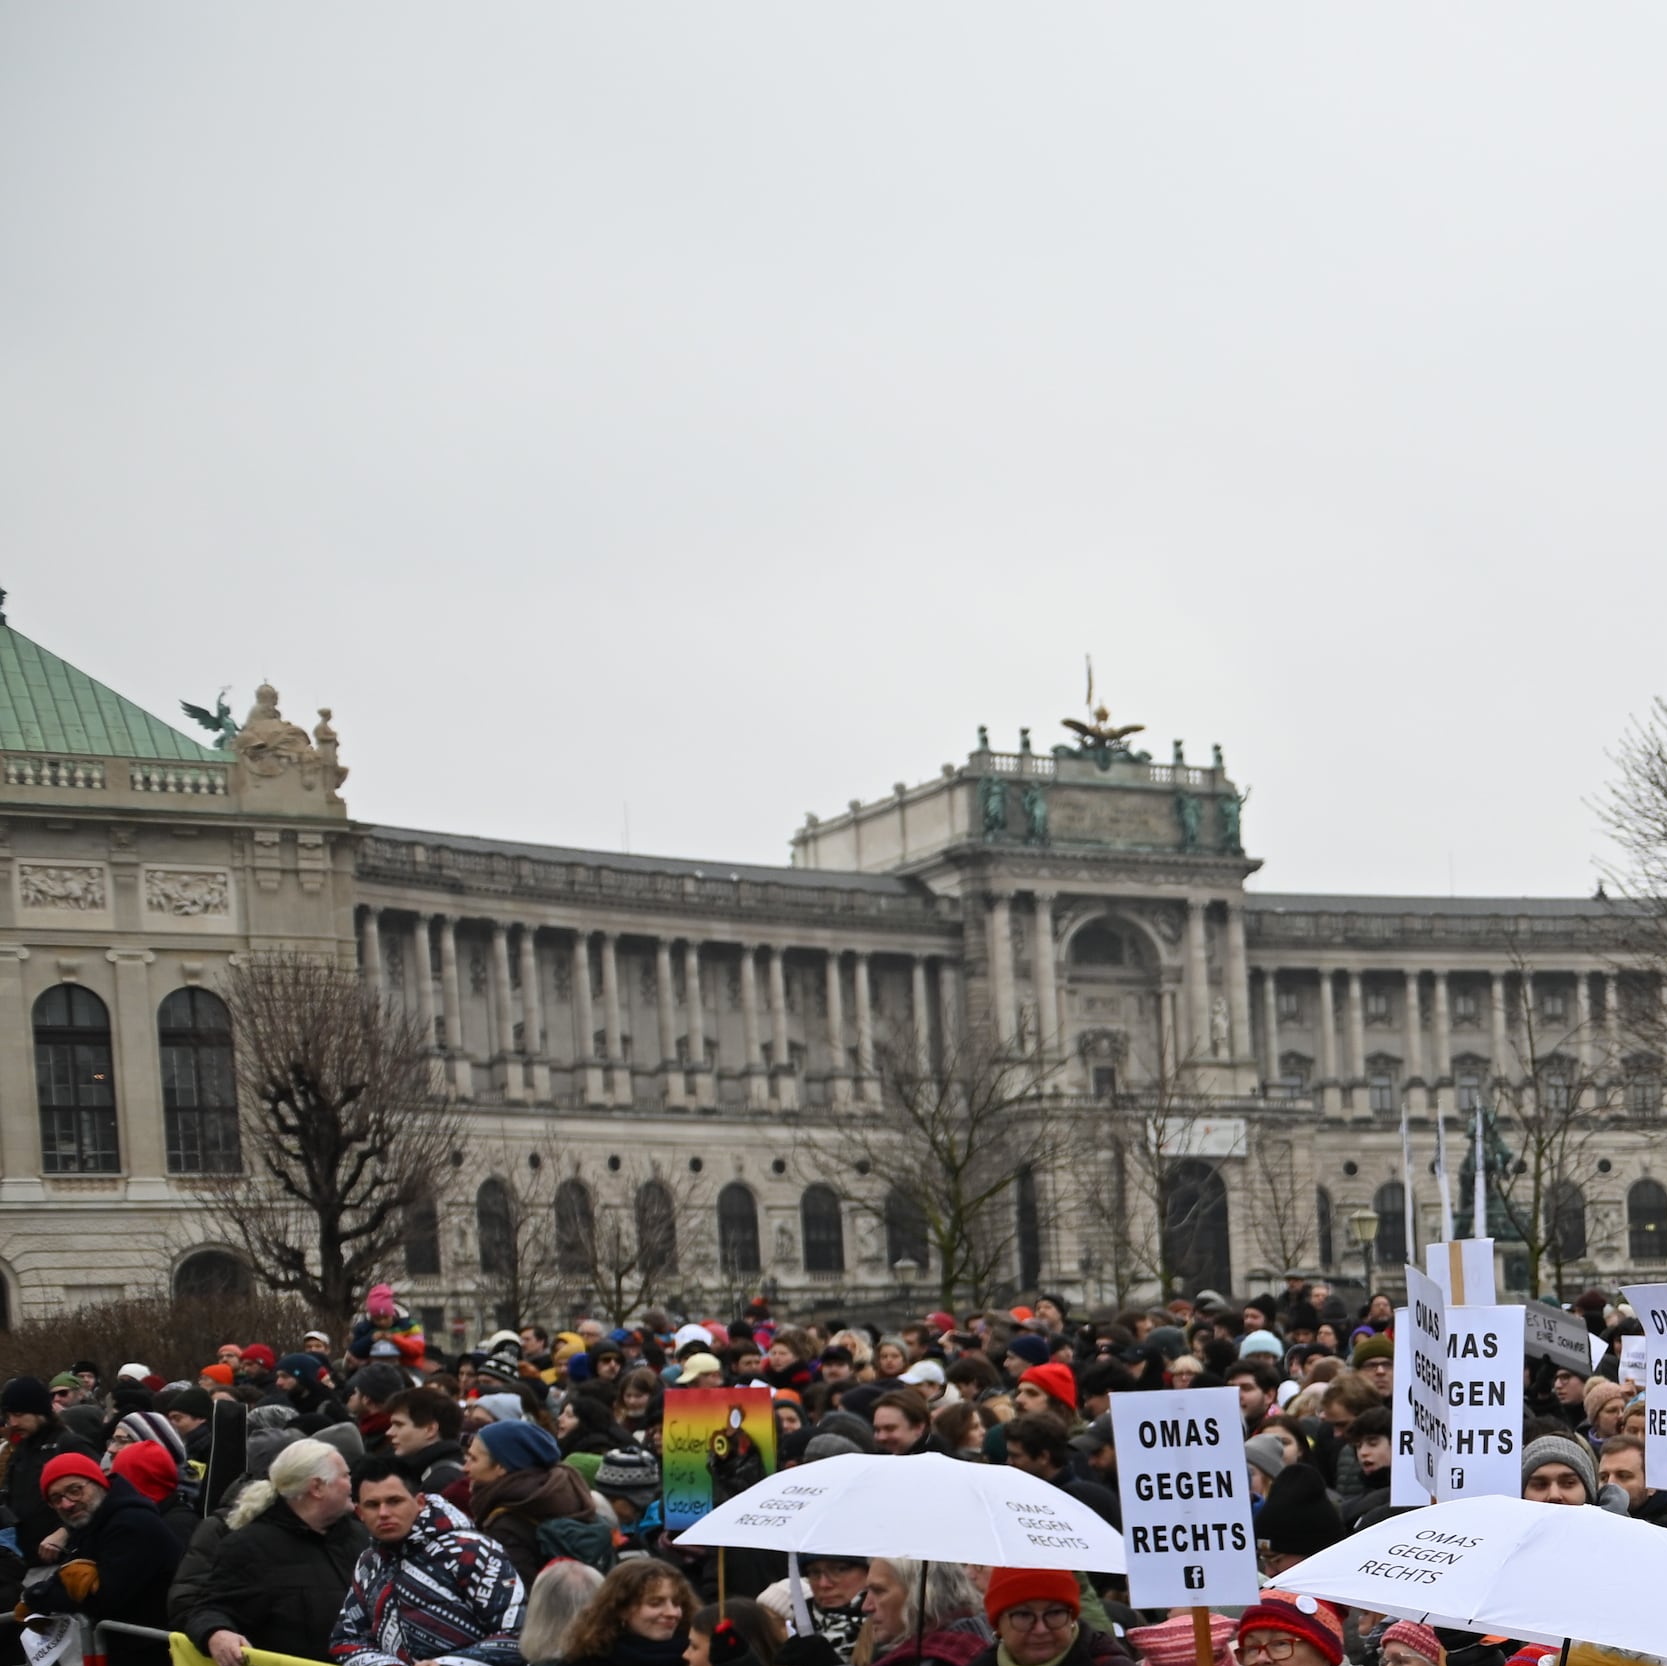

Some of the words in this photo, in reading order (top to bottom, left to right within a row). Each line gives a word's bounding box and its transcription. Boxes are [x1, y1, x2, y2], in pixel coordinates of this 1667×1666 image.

[1414, 1299, 1440, 1341] OMAS
[1447, 1333, 1498, 1358] MAS
[1414, 1350, 1443, 1397] GEGEN
[1139, 1417, 1221, 1450] OMAS
[1414, 1404, 1448, 1449] RECHTS
[1399, 1428, 1514, 1455] RHTS
[782, 1485, 828, 1496] OMAS
[1136, 1470, 1234, 1501] GEGEN
[759, 1498, 809, 1511] GEGEN
[1006, 1501, 1055, 1516] OMAS
[735, 1513, 791, 1527] RECHTS
[1018, 1516, 1073, 1533] GEGEN
[1027, 1533, 1089, 1550] RECHTS
[1131, 1523, 1247, 1554] RECHTS
[1415, 1529, 1484, 1549] OMAS
[1388, 1544, 1464, 1566] GEGEN
[476, 1555, 502, 1609] JEANS
[1358, 1559, 1443, 1585] RECHTS
